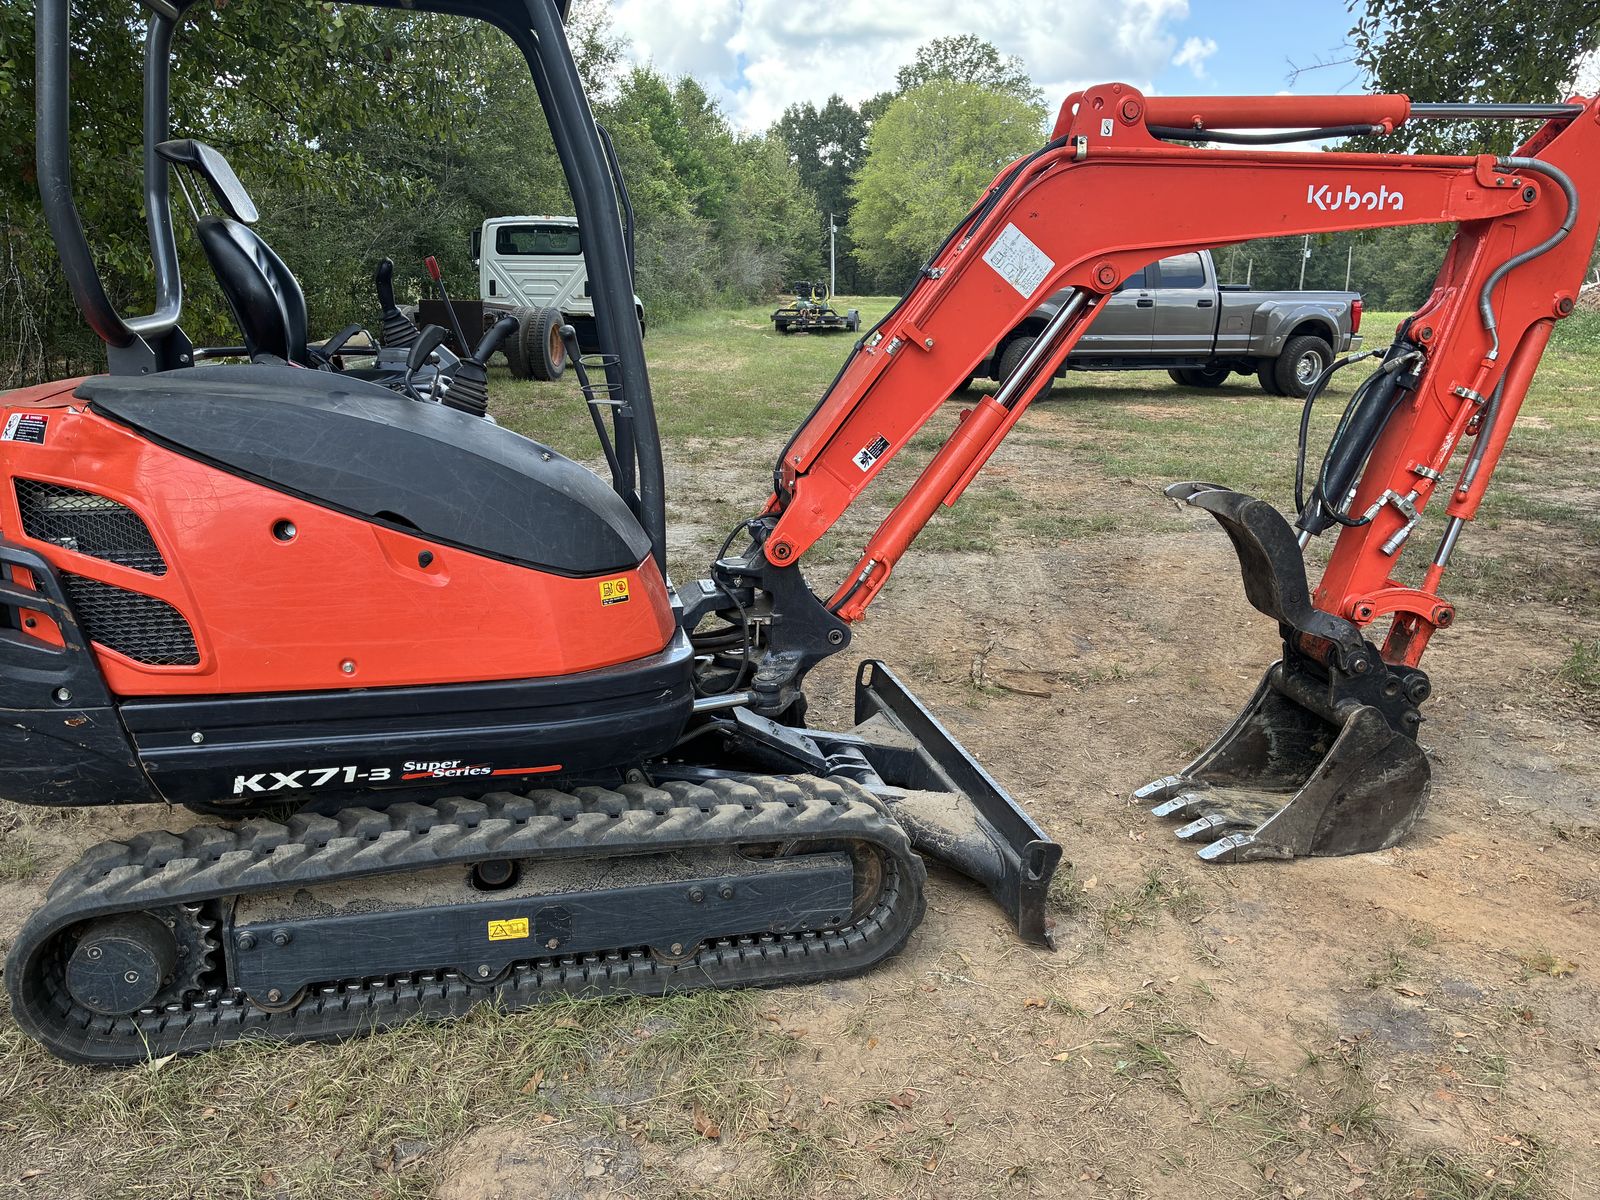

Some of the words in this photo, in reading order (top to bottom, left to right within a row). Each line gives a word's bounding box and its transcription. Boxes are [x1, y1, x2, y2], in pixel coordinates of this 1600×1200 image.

[1307, 184, 1404, 210] Kubota
[403, 760, 461, 773] Super
[432, 766, 491, 778] Series
[233, 765, 391, 794] KX71-3
